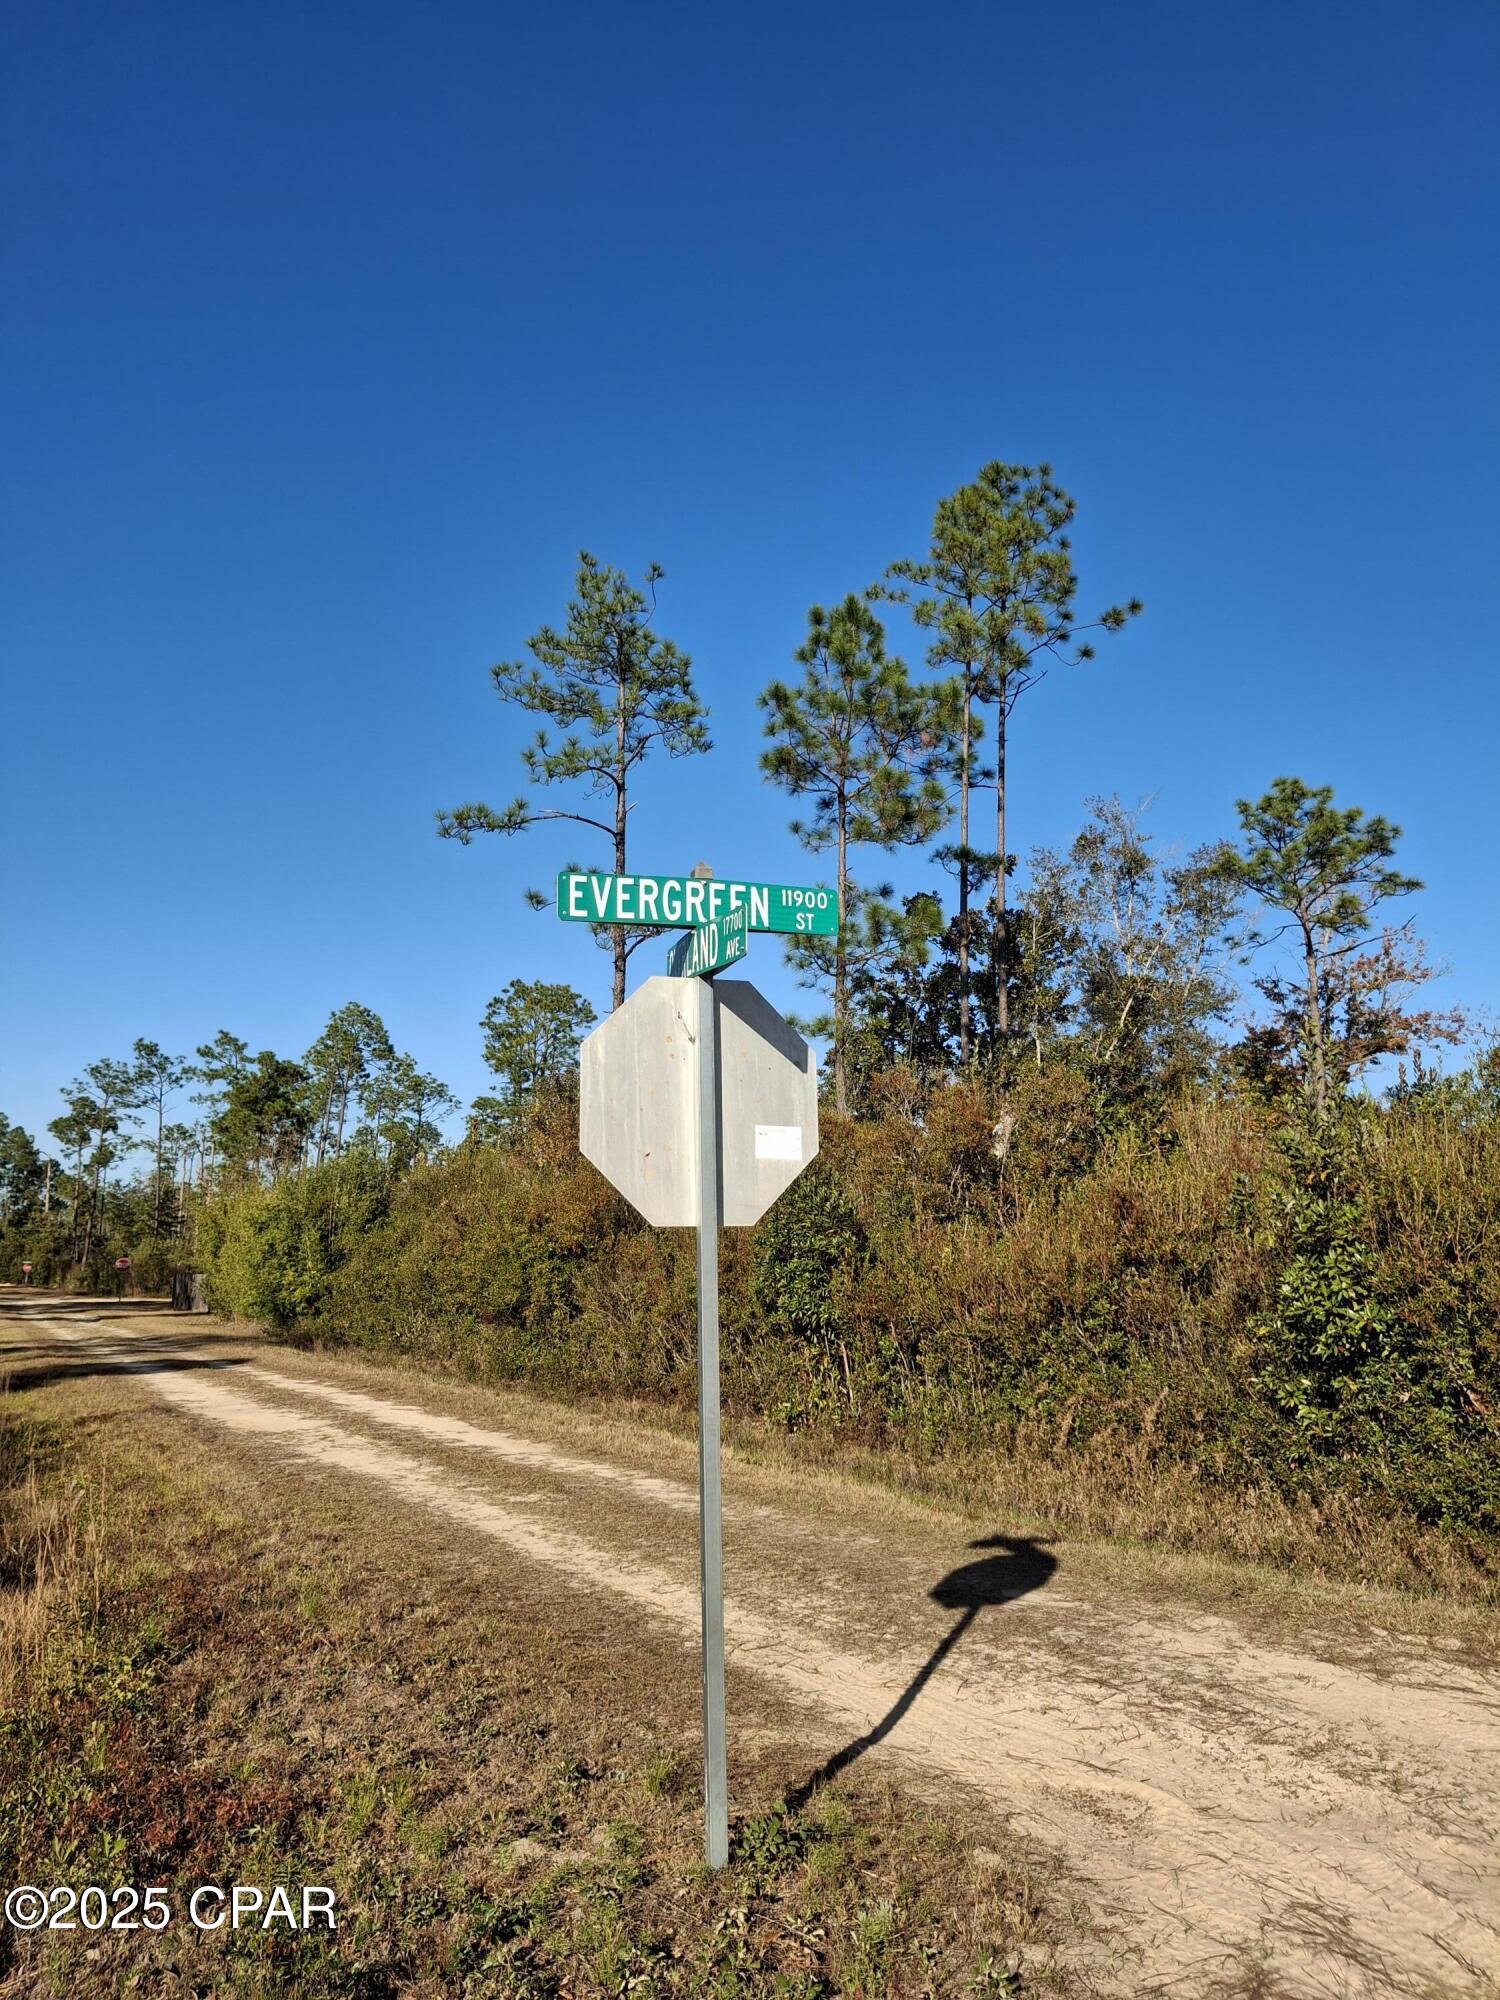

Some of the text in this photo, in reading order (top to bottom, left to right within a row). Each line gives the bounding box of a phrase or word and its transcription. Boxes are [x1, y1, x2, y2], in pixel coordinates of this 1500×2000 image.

[569, 875, 769, 927] EVERGREEN
[781, 889, 827, 910] 11900
[723, 911, 743, 936] 17700
[795, 912, 815, 931] ST
[725, 936, 740, 960] AVE
